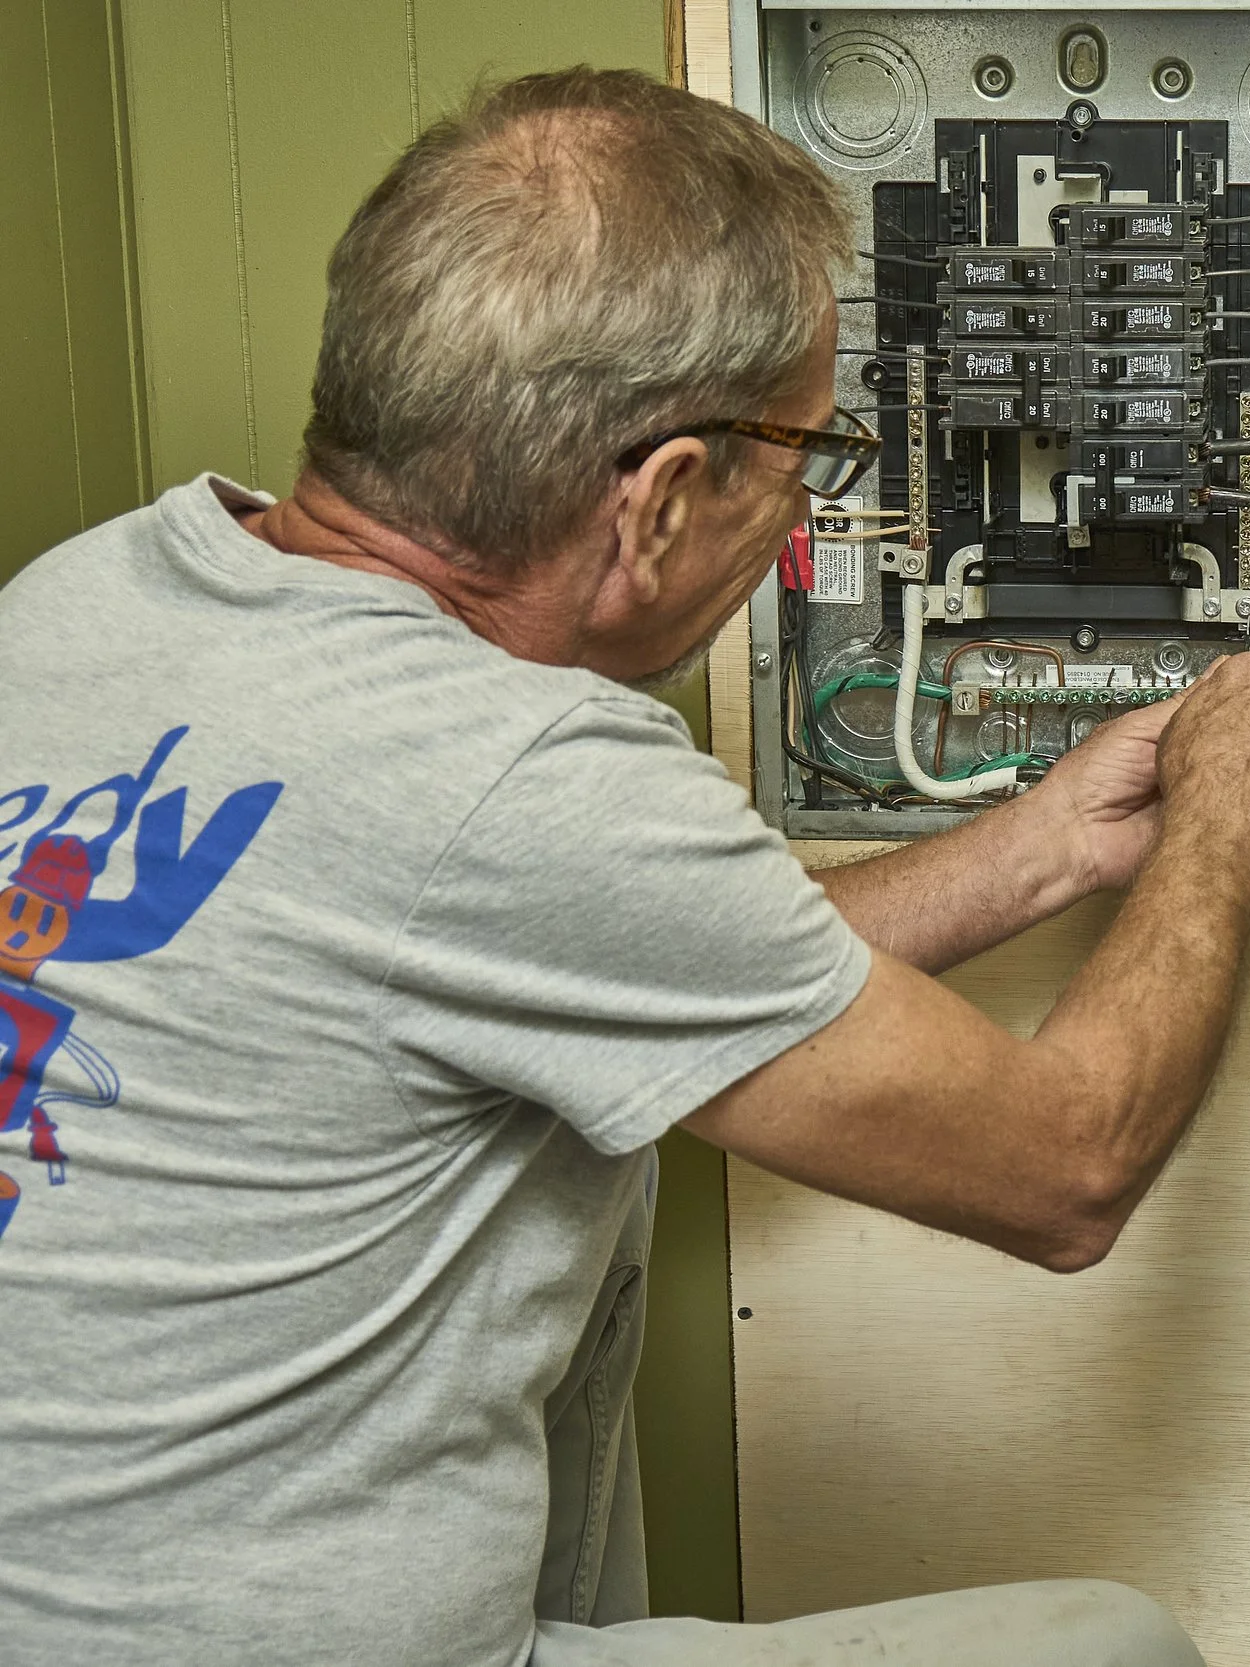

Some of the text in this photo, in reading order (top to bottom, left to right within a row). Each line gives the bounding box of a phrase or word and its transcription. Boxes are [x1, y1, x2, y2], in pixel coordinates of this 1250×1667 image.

[1028, 269, 1035, 277] 15
[1028, 315, 1035, 323] 15
[1100, 317, 1107, 327] 20
[1029, 361, 1036, 371] 20
[1100, 363, 1107, 373] 20
[1029, 405, 1036, 416] 20
[1101, 409, 1107, 419] 20
[838, 549, 842, 557] TO
[819, 566, 823, 574] OF
